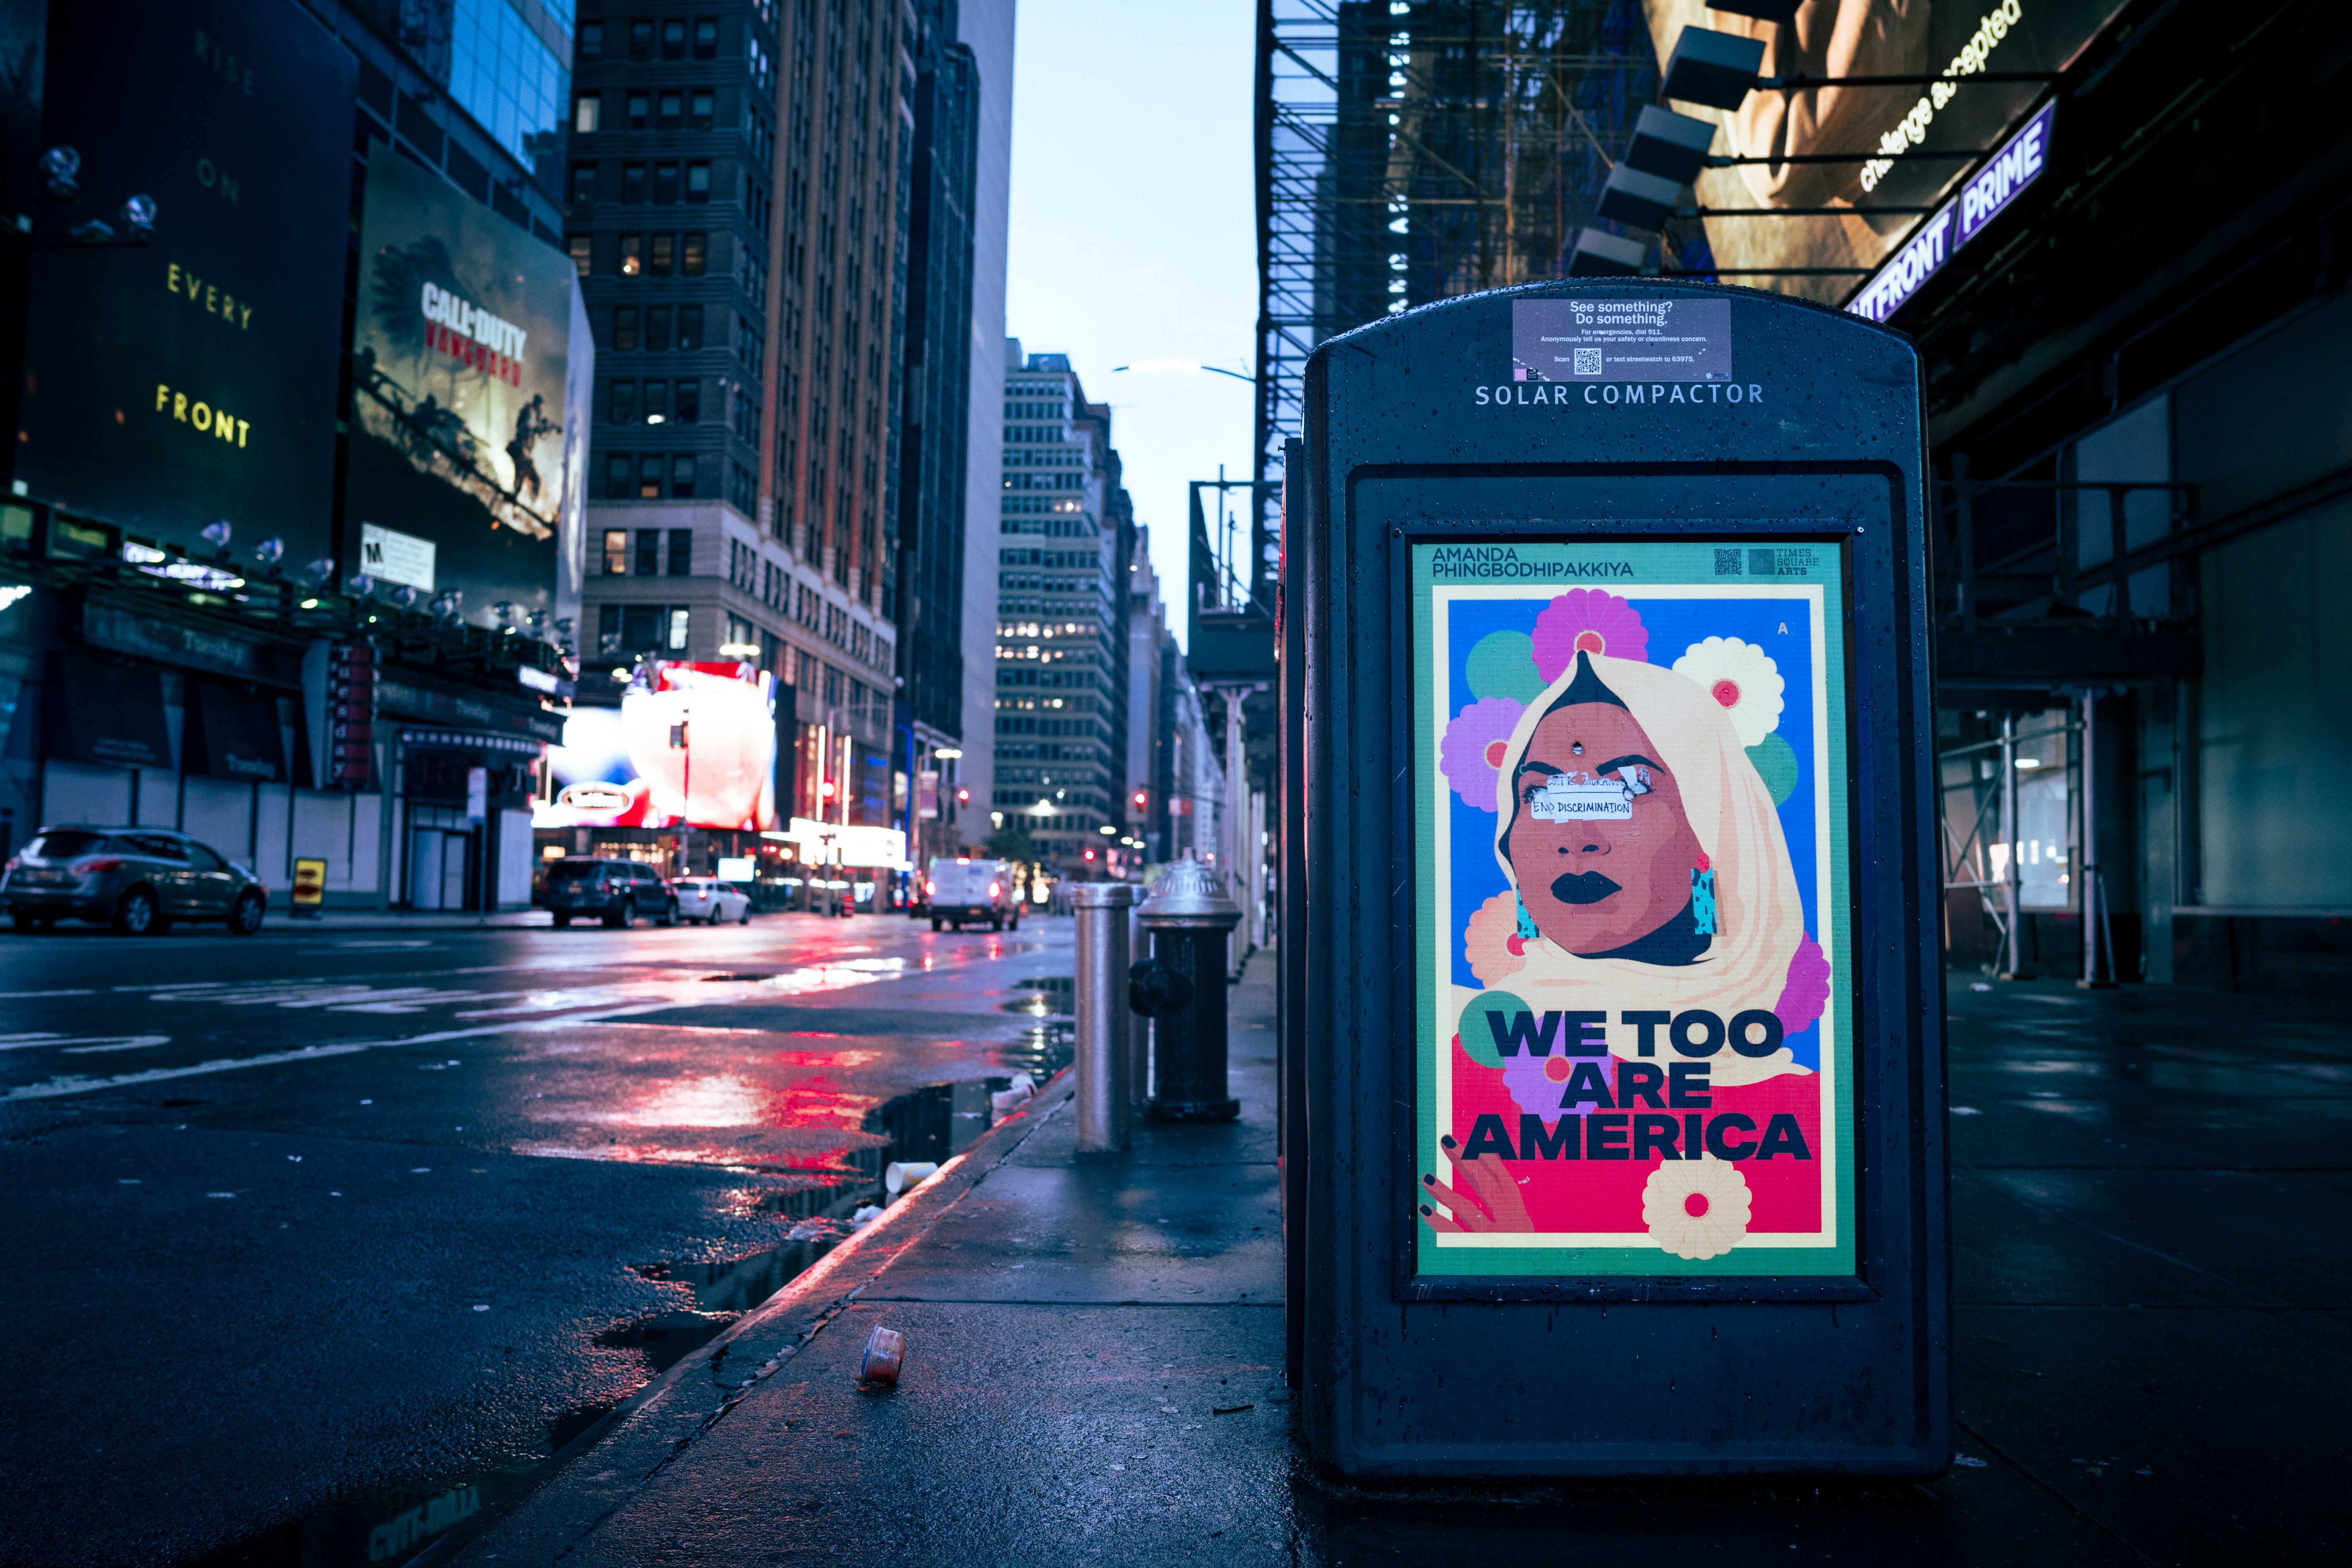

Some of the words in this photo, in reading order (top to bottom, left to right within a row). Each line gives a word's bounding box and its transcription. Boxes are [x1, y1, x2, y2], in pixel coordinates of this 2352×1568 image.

[195, 30, 254, 97] RISE
[1861, 98, 1933, 192] challenge
[196, 157, 239, 204] ON
[1963, 121, 2042, 234] PRIME
[167, 263, 252, 329] EVERY
[1570, 301, 1594, 312] See
[1598, 301, 1673, 315] something?
[1576, 313, 1593, 324] Do
[1597, 313, 1667, 327] something.
[425, 321, 521, 387] VANGUARD
[156, 384, 250, 448] FRONT
[1476, 385, 1568, 405] SOLAR
[1584, 384, 1763, 405] COMPACTOR
[1432, 548, 1518, 562] AMANDA
[1432, 563, 1633, 577] PHINGBODHIPAKKIYA
[1778, 622, 1788, 634] A
[1534, 802, 1555, 812] END
[1558, 802, 1630, 812] DISCRIMINATION
[1485, 1010, 1608, 1057] WE
[1622, 1009, 1784, 1058] TOO
[1559, 1062, 1712, 1109] ARE
[1460, 1113, 1812, 1161] AMERICA
